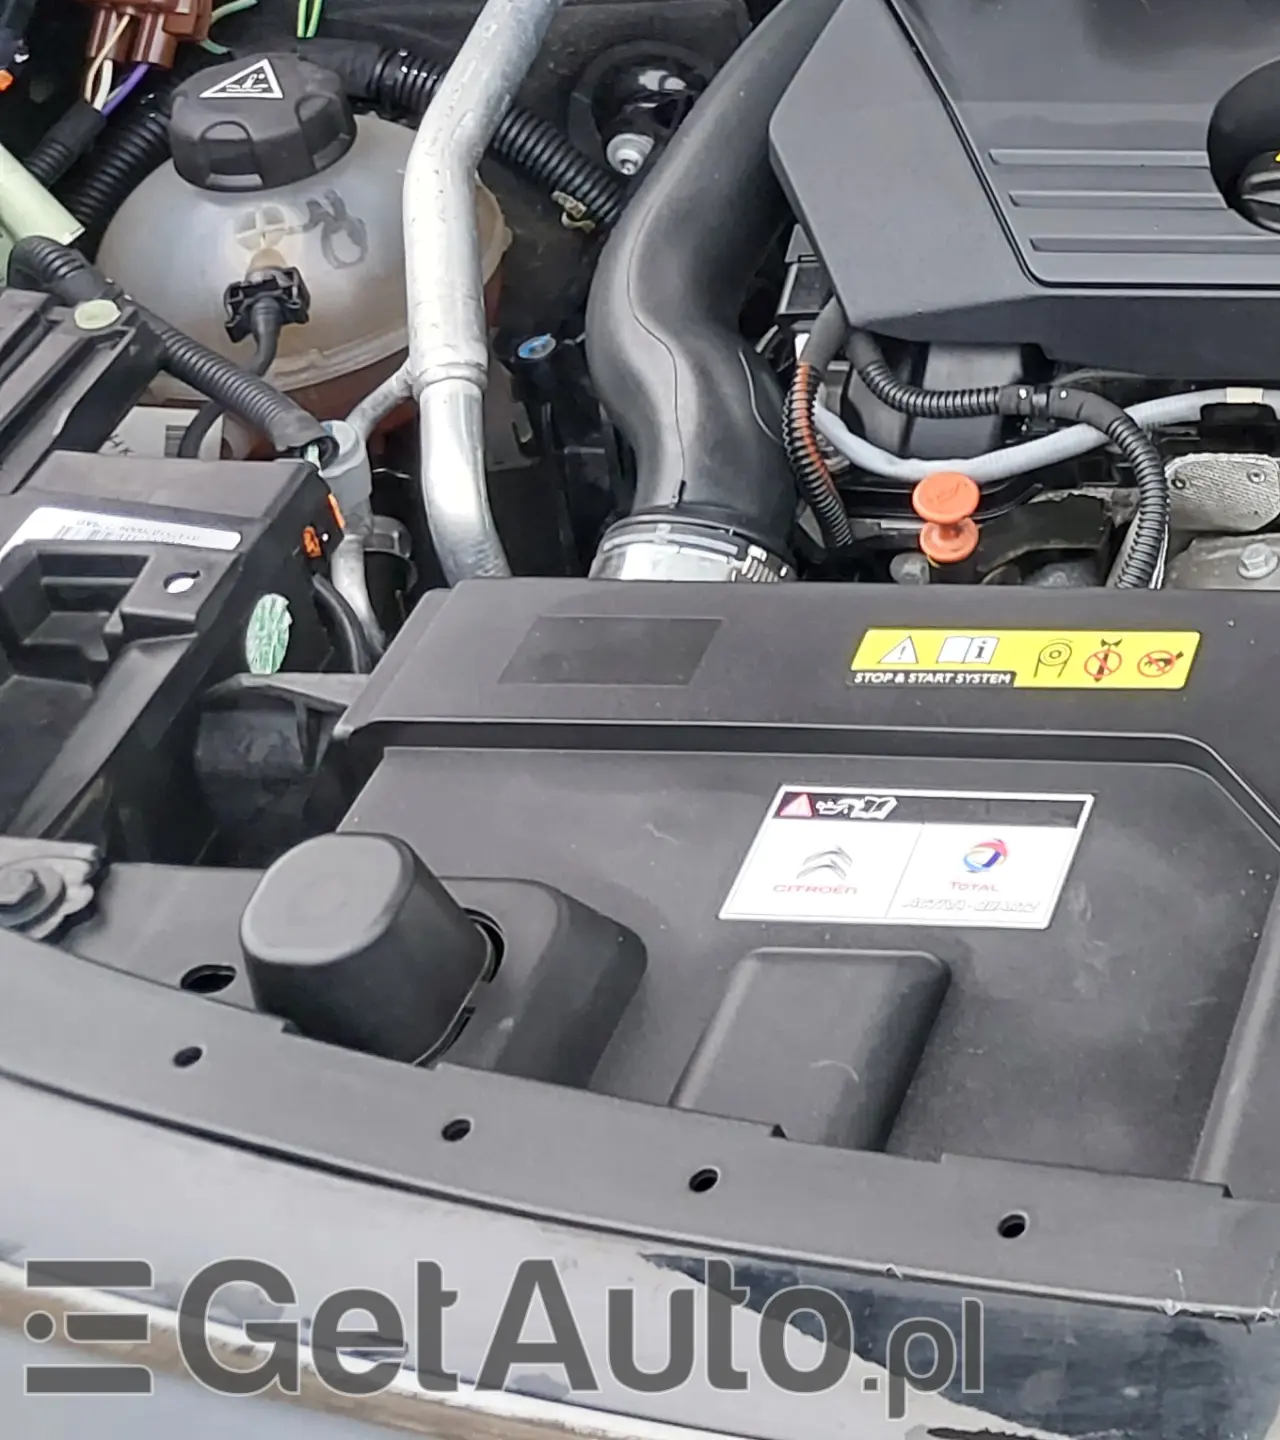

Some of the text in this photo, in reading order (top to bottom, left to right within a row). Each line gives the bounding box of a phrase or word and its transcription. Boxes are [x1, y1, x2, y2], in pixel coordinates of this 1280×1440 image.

[854, 672, 1012, 685] STOP & START SYSTEM
[950, 881, 999, 893] TOTAL
